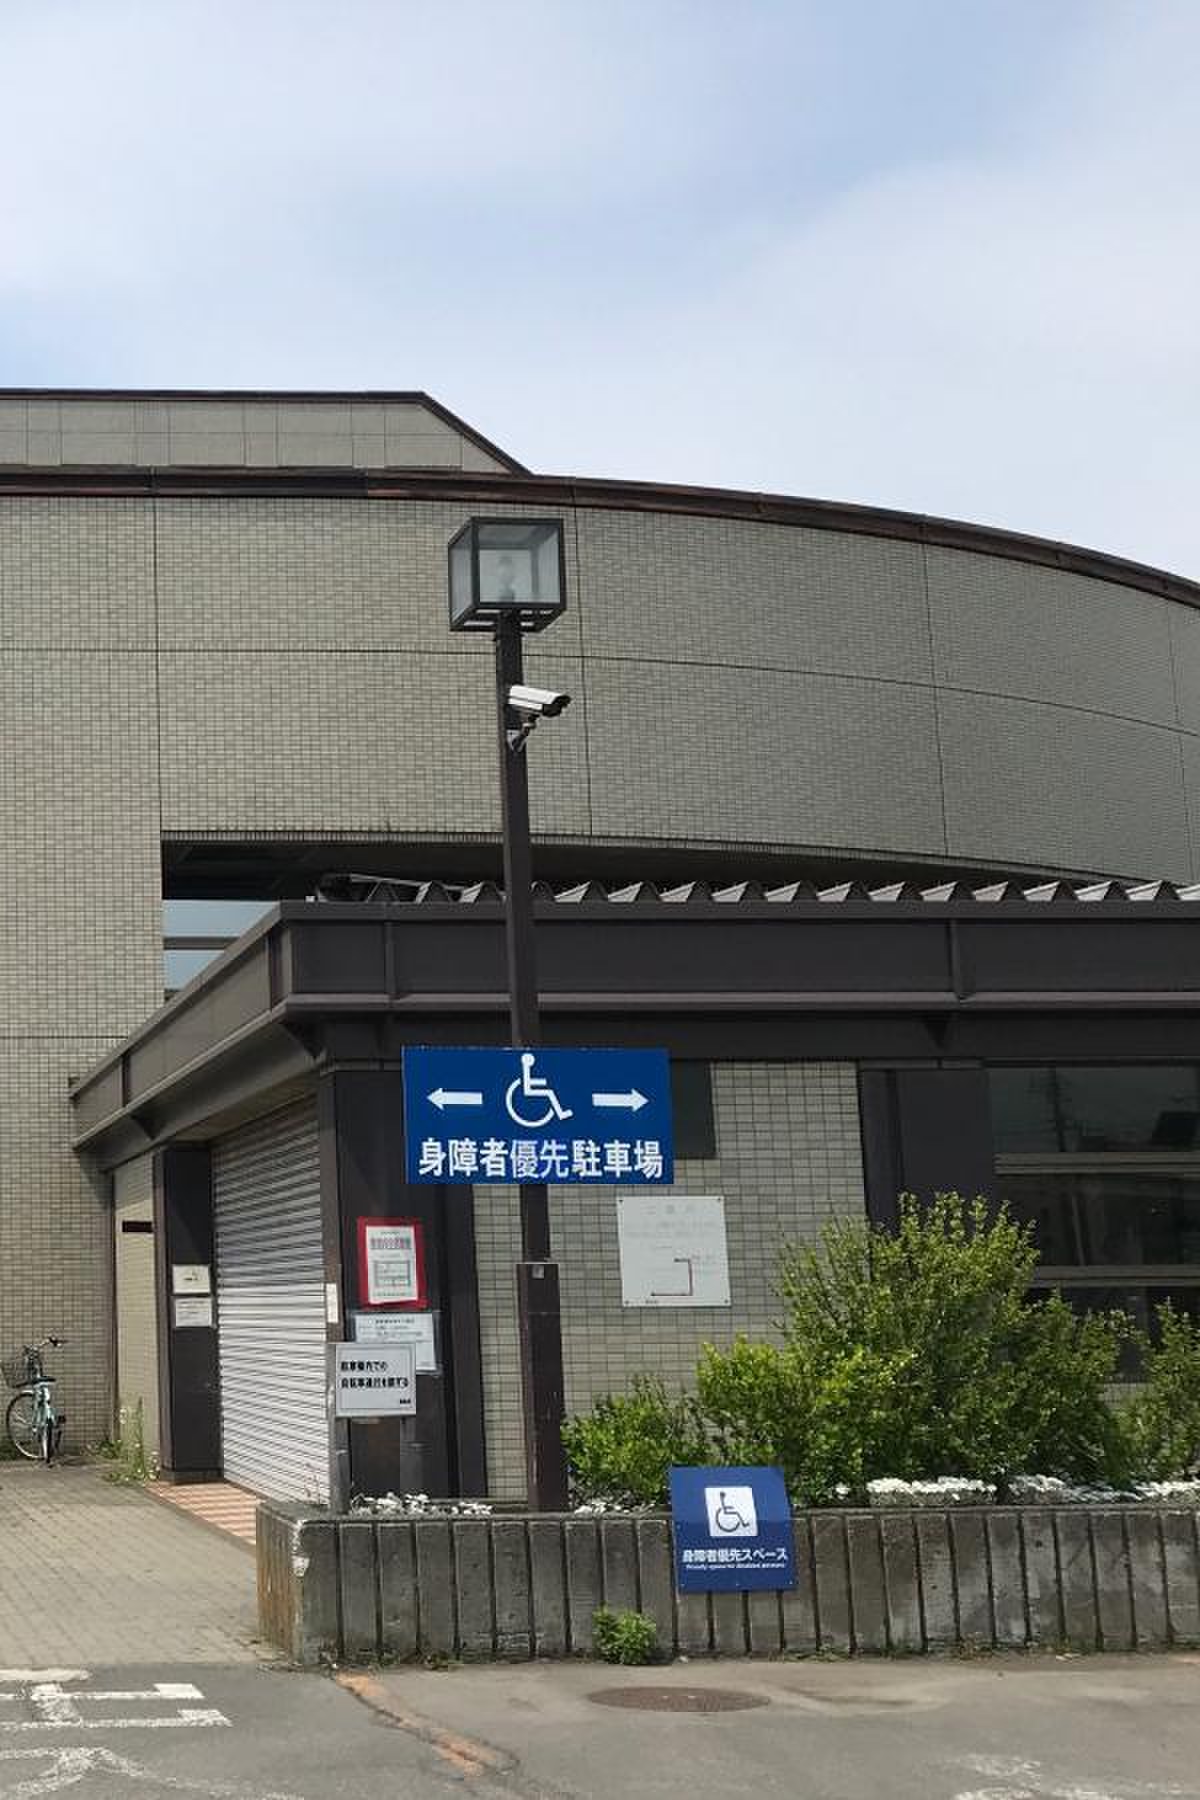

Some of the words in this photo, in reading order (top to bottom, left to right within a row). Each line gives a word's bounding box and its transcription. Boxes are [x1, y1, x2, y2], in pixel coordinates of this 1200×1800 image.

[418, 1137, 664, 1179] 身障者優先駐車場
[682, 1547, 788, 1563] 身障者優先スペース
